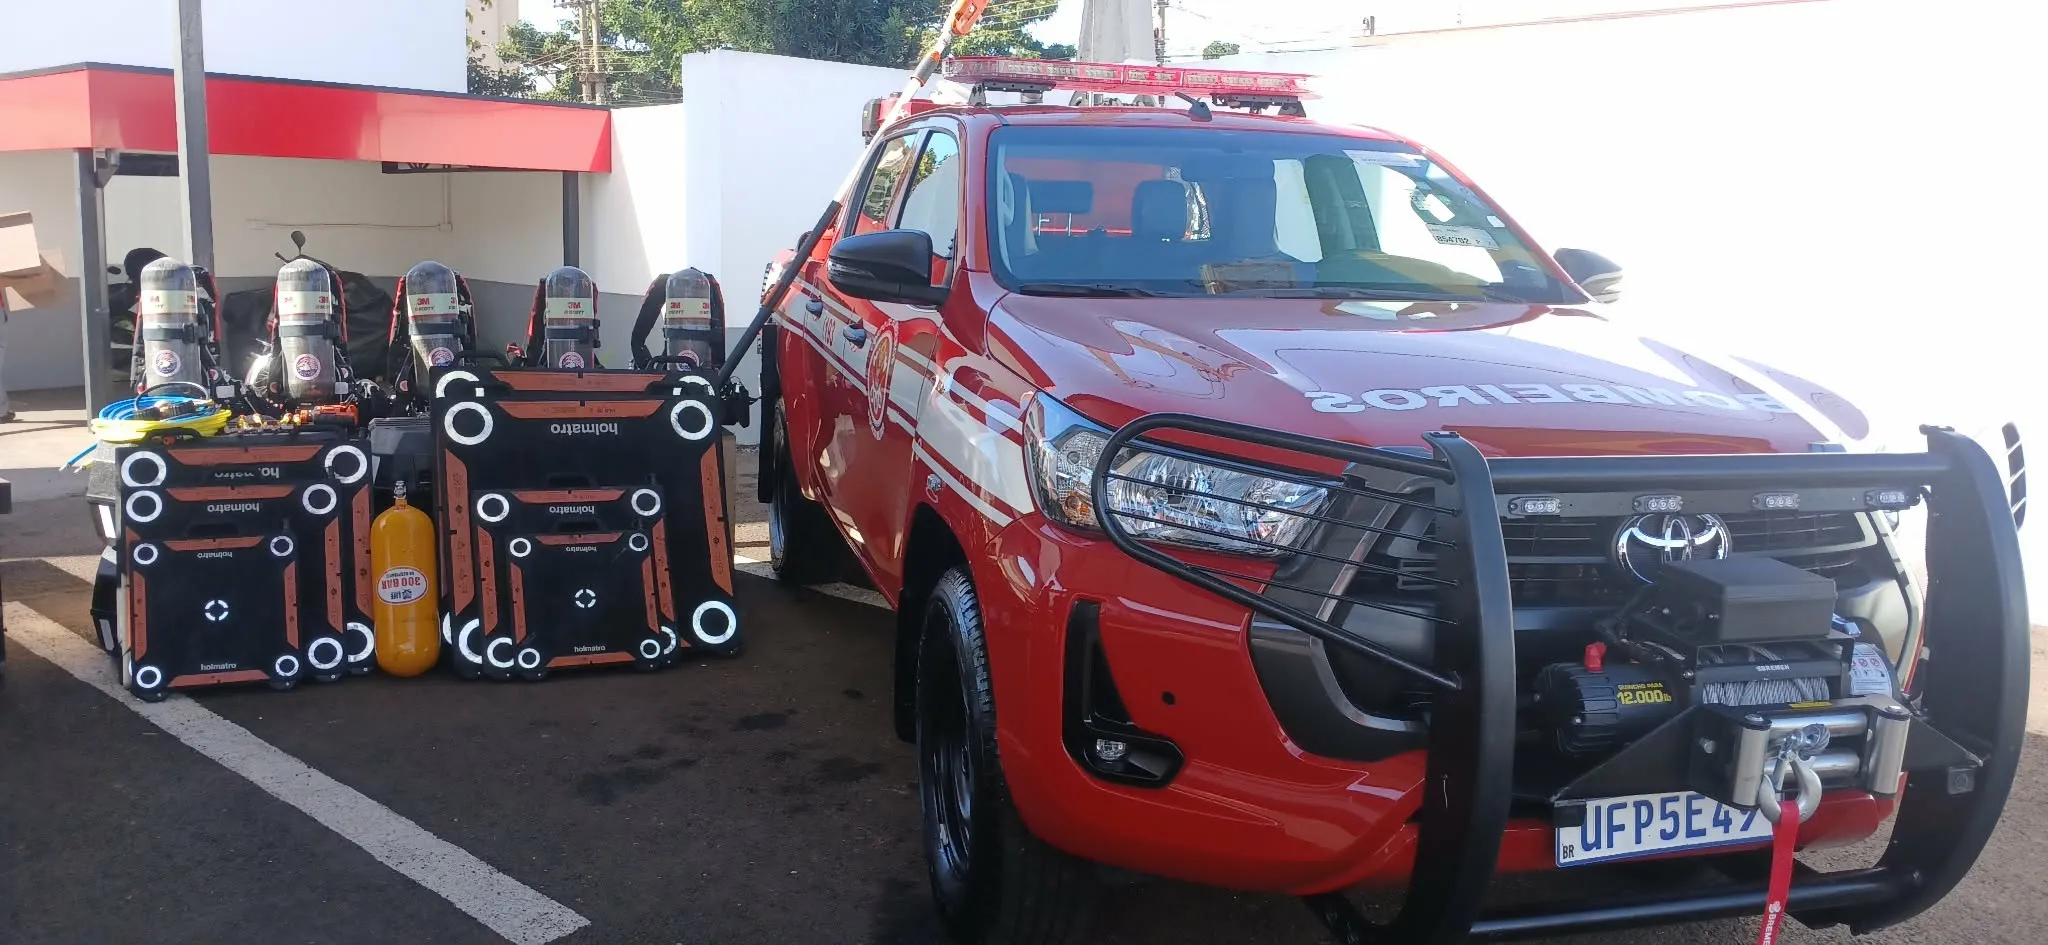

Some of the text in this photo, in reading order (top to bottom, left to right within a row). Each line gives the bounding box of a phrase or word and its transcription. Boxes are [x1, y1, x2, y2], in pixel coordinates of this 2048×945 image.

[568, 301, 582, 309] 3M
[550, 422, 619, 436] holmatro
[207, 502, 260, 514] holmatro
[549, 505, 595, 515] holmatro
[196, 551, 233, 559] holmatro
[381, 576, 421, 590] 300 BAR
[574, 645, 606, 653] holmatro
[200, 662, 237, 671] holmatro
[1562, 844, 1575, 860] BR
